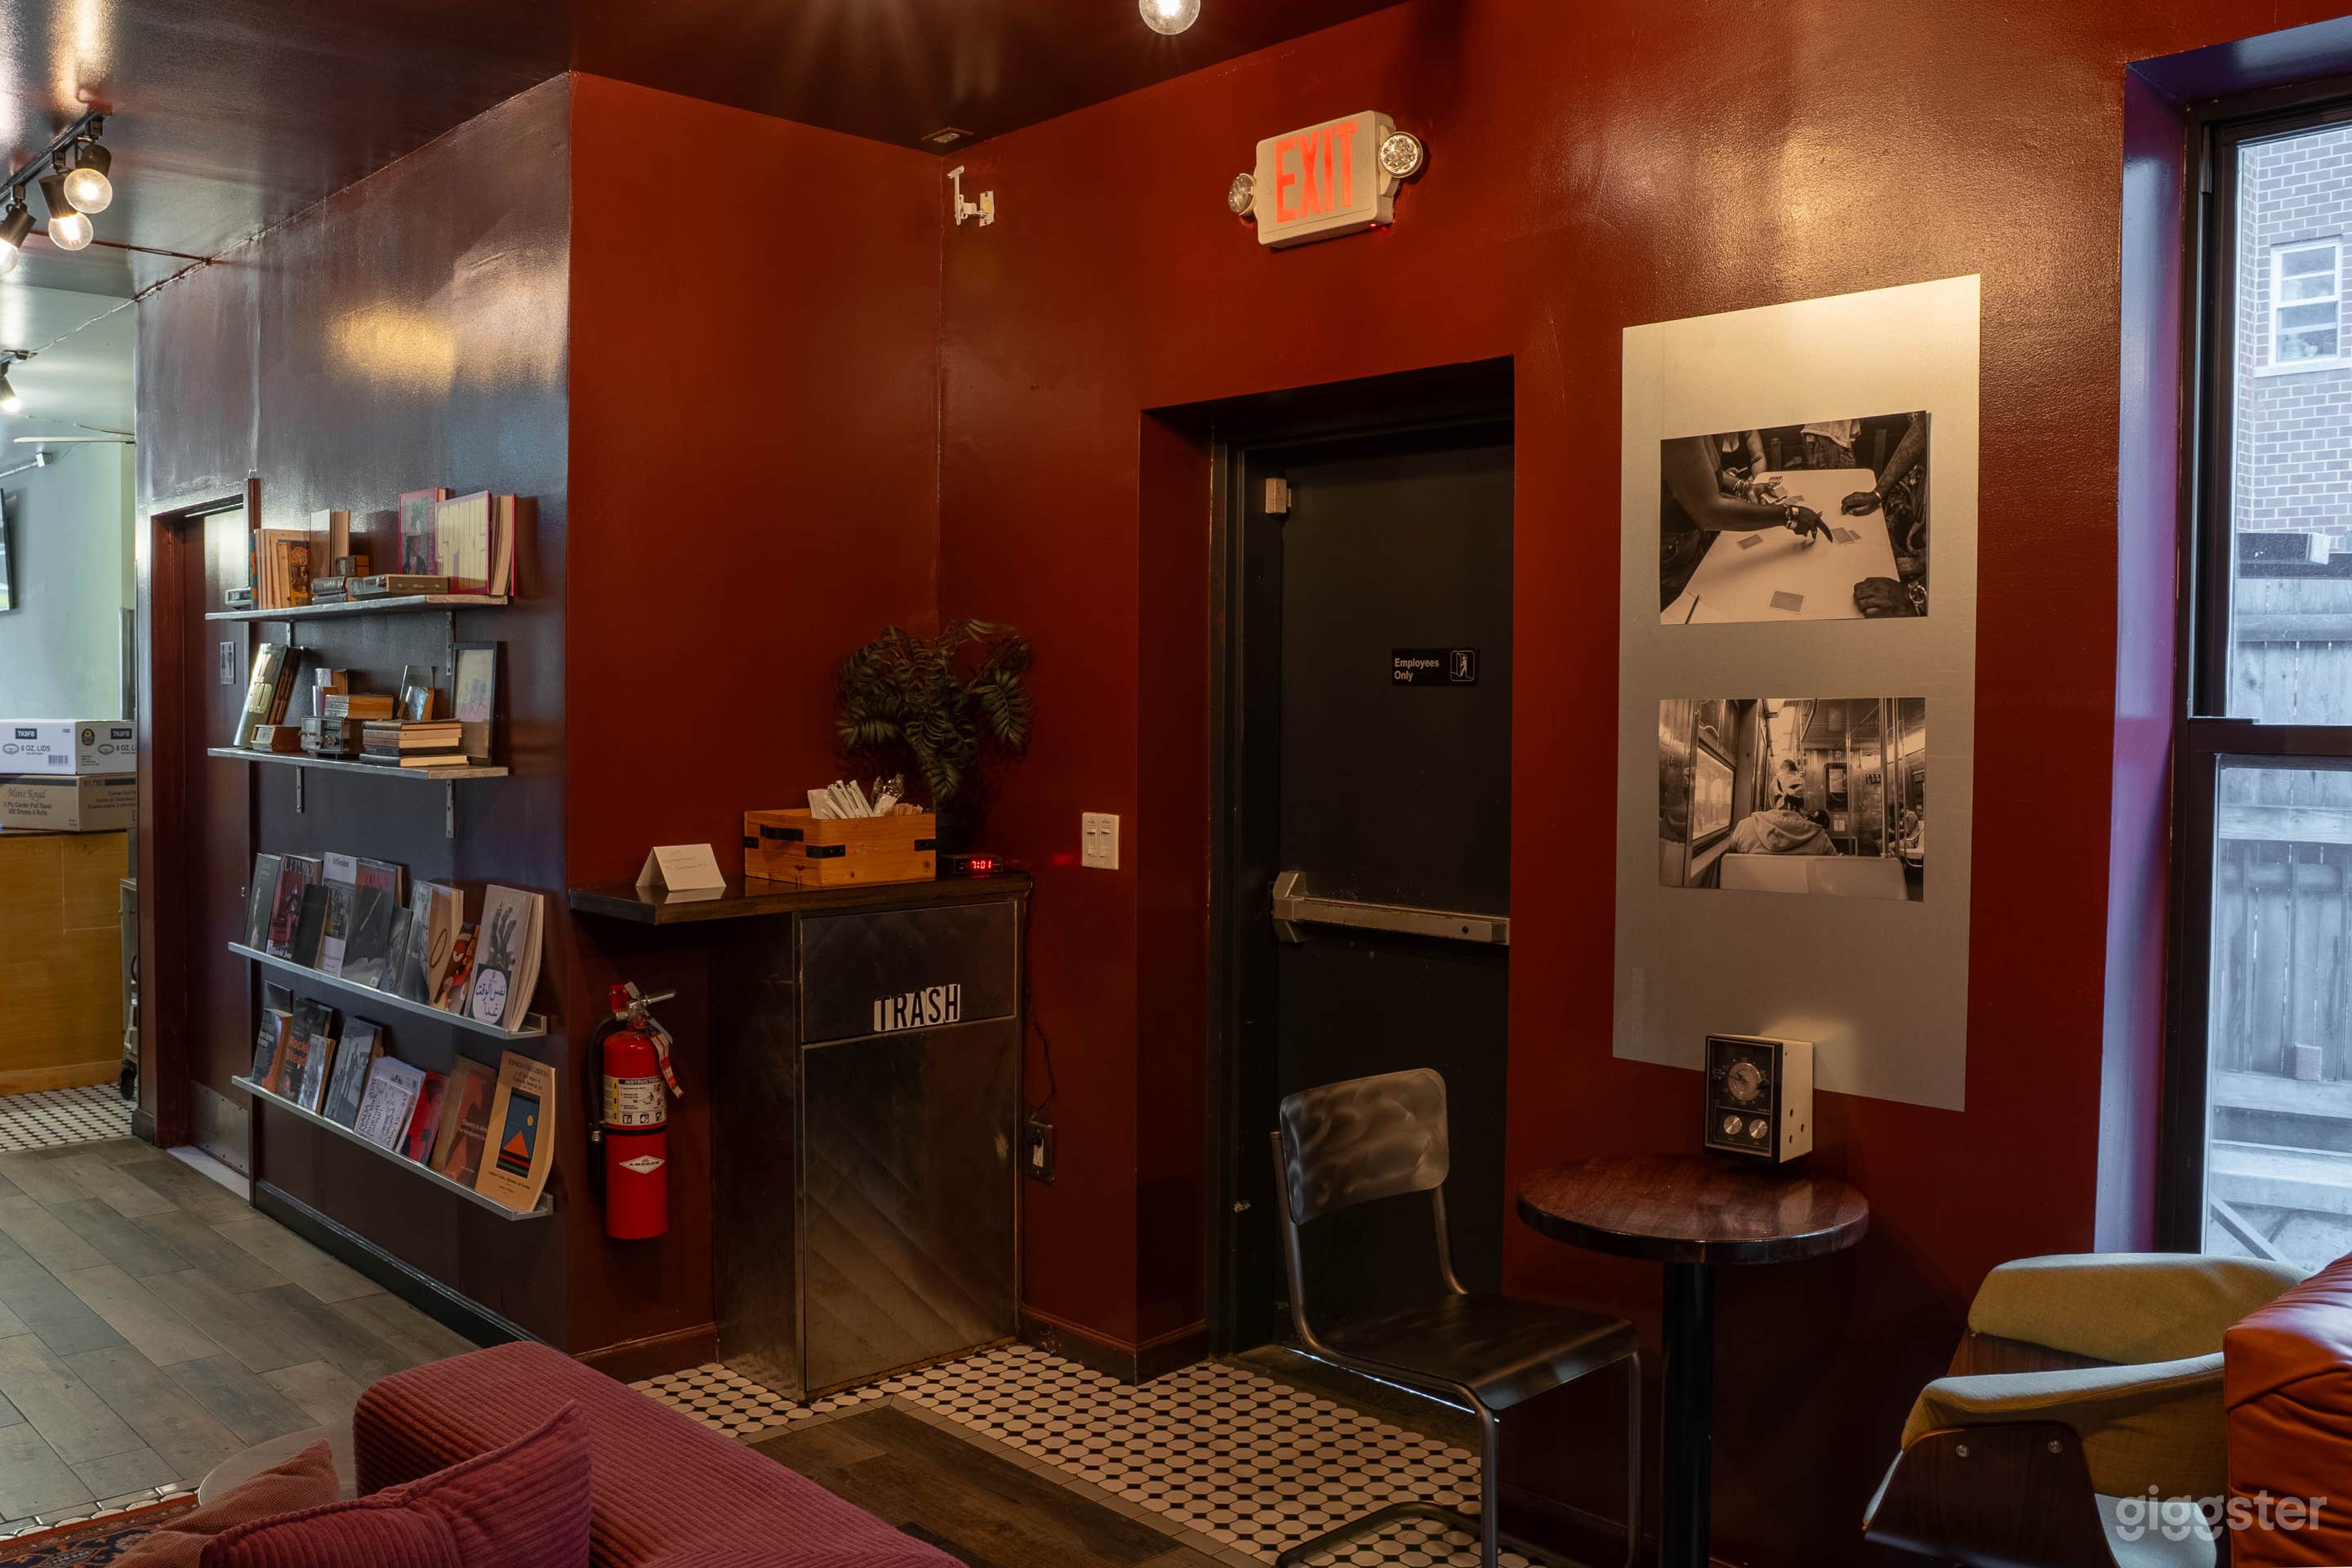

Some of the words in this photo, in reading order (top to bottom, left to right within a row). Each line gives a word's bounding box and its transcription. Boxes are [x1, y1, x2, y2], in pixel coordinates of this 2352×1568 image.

[1273, 120, 1358, 223] EXIT
[1394, 657, 1440, 669] Employees
[1394, 670, 1414, 682] Only
[971, 860, 992, 870] 7:01
[874, 983, 960, 1031] TRASH
